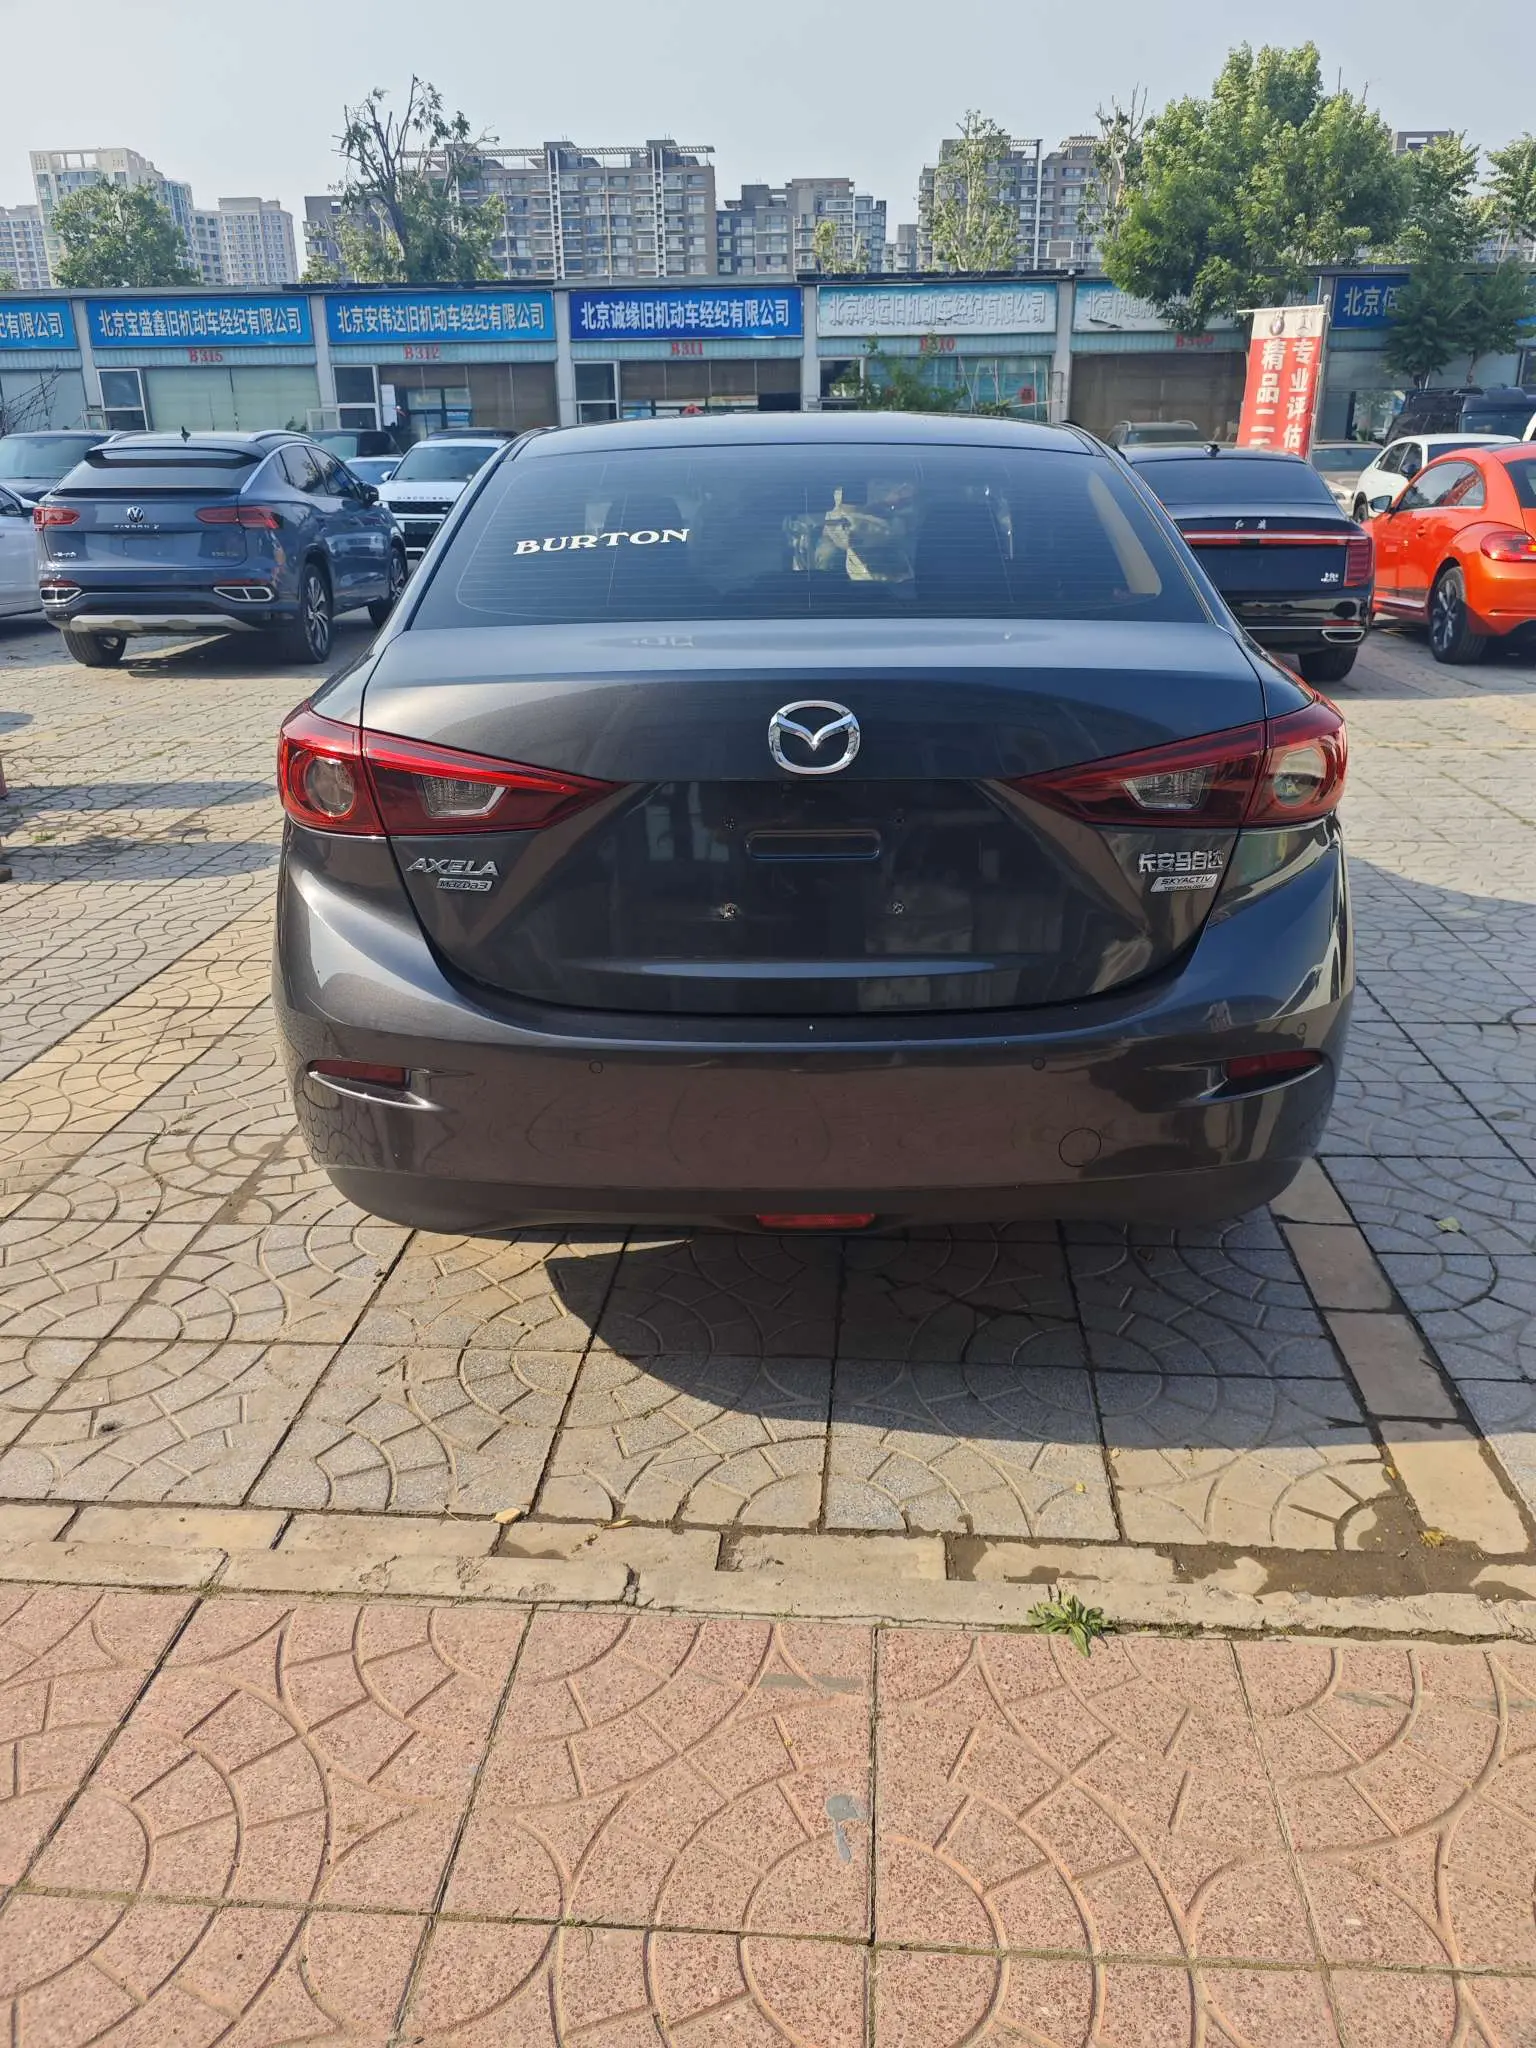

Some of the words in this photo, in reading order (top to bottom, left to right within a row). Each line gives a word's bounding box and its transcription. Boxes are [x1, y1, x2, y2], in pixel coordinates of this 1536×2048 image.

[99, 307, 302, 337] 北京宝盛鑫旧机动车经纪有限公司
[337, 302, 545, 333] 北京安伟达旧机动车经纪有限公司
[581, 299, 790, 330] 北京诚缘旧机动车经纪有限公司
[404, 344, 441, 360] B312
[1282, 339, 1315, 454] 专业评估
[513, 528, 690, 556] BURTON
[405, 857, 499, 877] AXELA
[1138, 850, 1225, 873] 长安马自达
